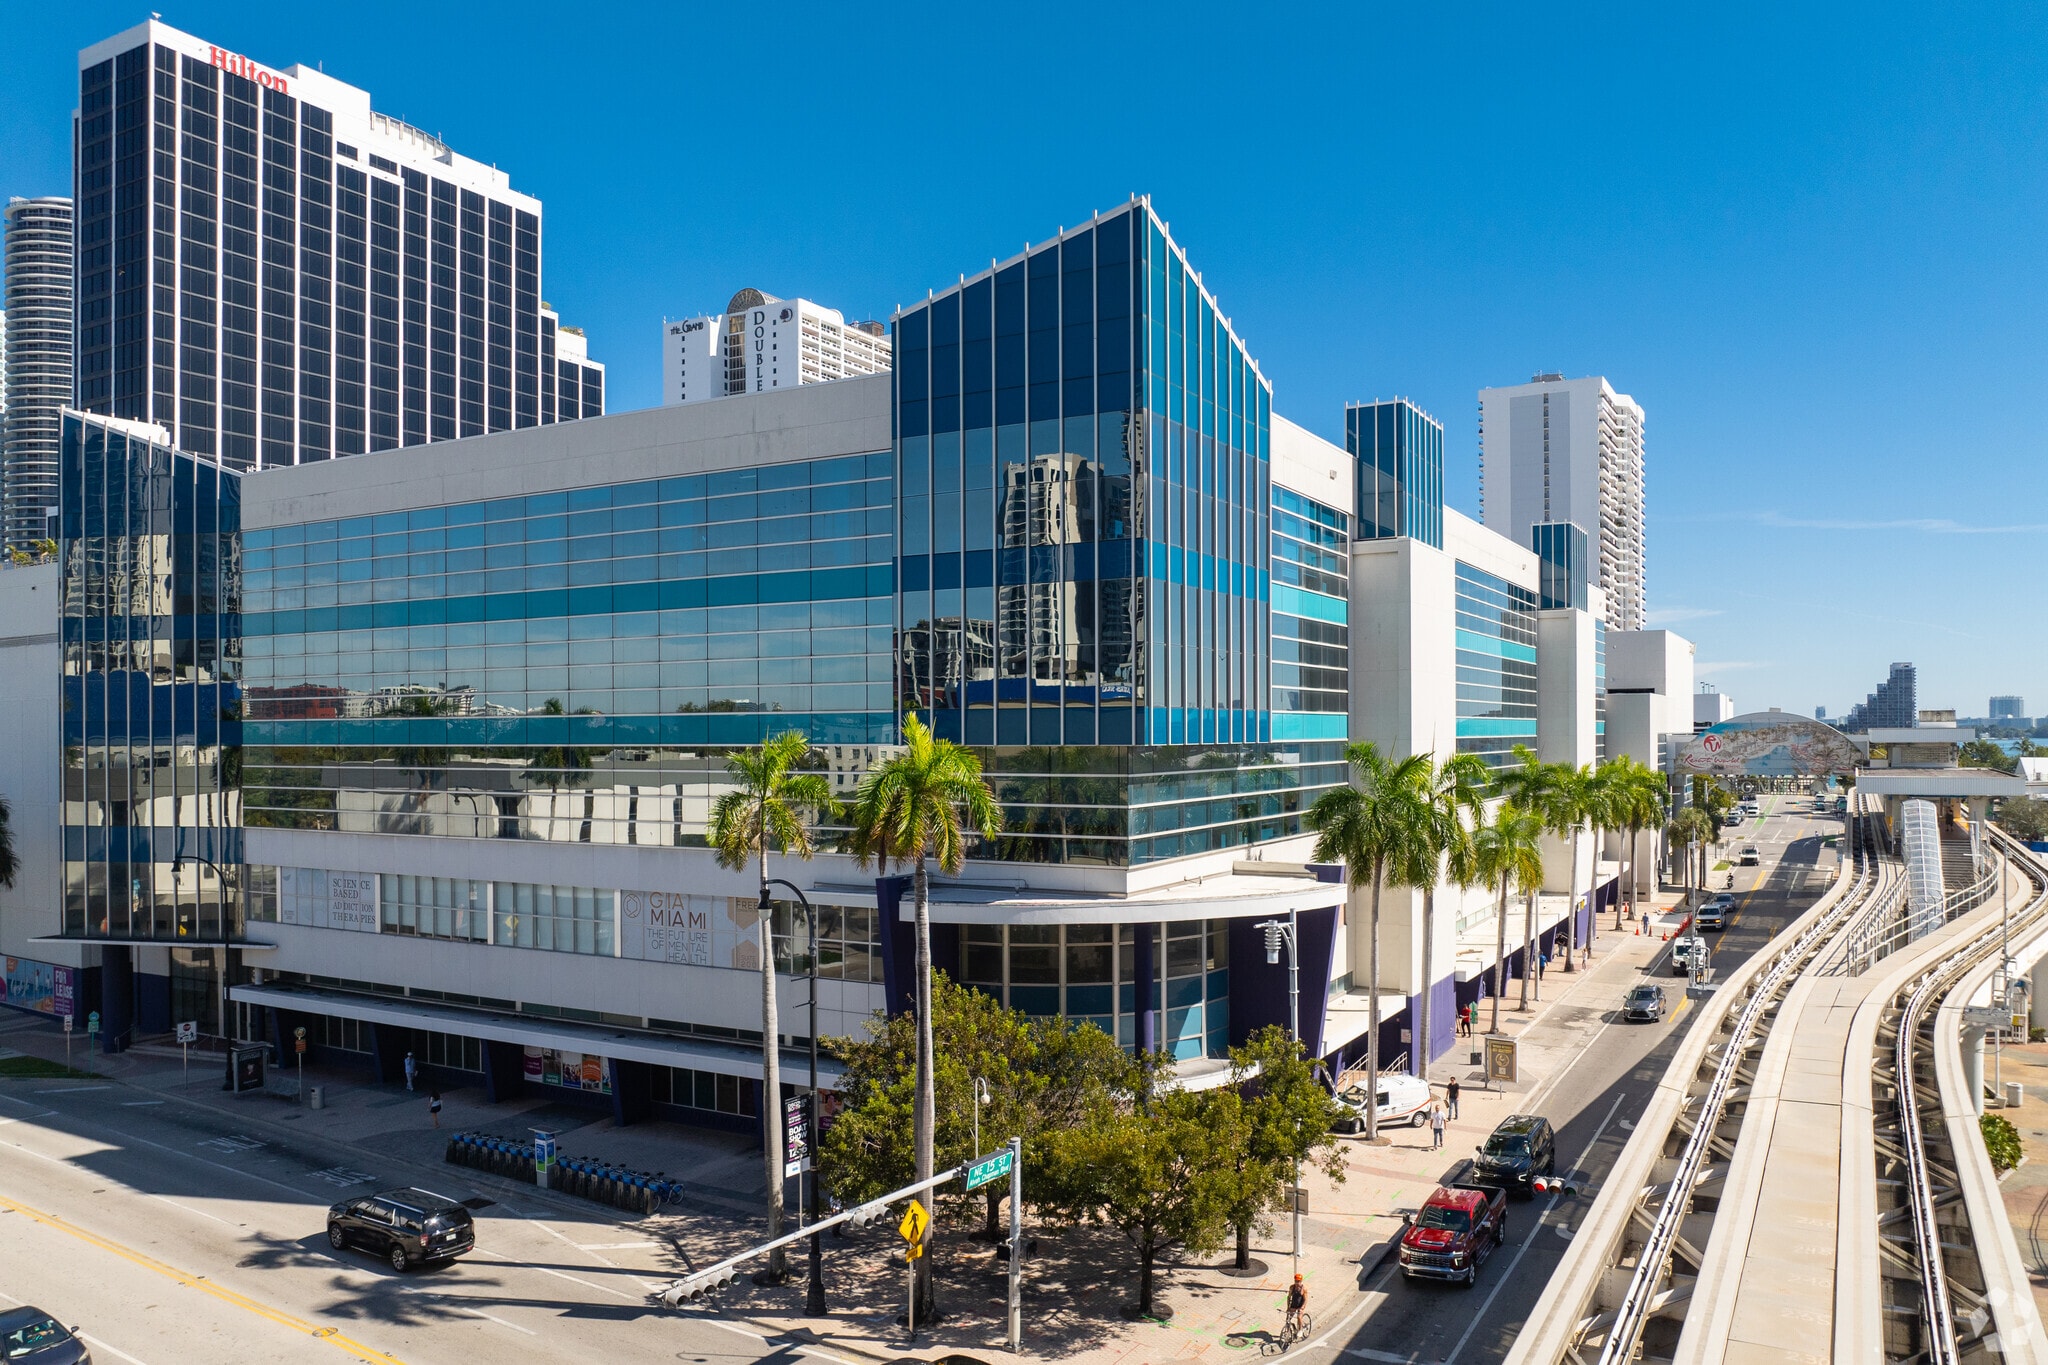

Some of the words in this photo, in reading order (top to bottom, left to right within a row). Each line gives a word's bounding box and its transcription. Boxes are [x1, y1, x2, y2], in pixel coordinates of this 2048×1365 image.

[209, 45, 289, 94] Hilton
[754, 310, 765, 392] DOUBLE
[333, 878, 371, 890] SCIENCE
[333, 888, 359, 899] BASED
[649, 891, 685, 910] GIA
[333, 901, 374, 913] ADDICTION
[736, 900, 758, 910] FREE
[332, 911, 376, 924] THERAPIES
[650, 908, 706, 930] MIAMI
[647, 928, 665, 940] THE
[668, 930, 708, 943] FUTURE
[651, 939, 665, 950] OF
[668, 941, 708, 954] MENTAL
[668, 952, 707, 965] HEALTH
[55, 970, 67, 984] FOR
[55, 984, 73, 999] LEASE
[788, 1123, 808, 1136] BOAT
[788, 1131, 808, 1144] SHOW
[974, 1166, 984, 1177] NE
[986, 1159, 995, 1173] 15
[998, 1155, 1007, 1167] ST
